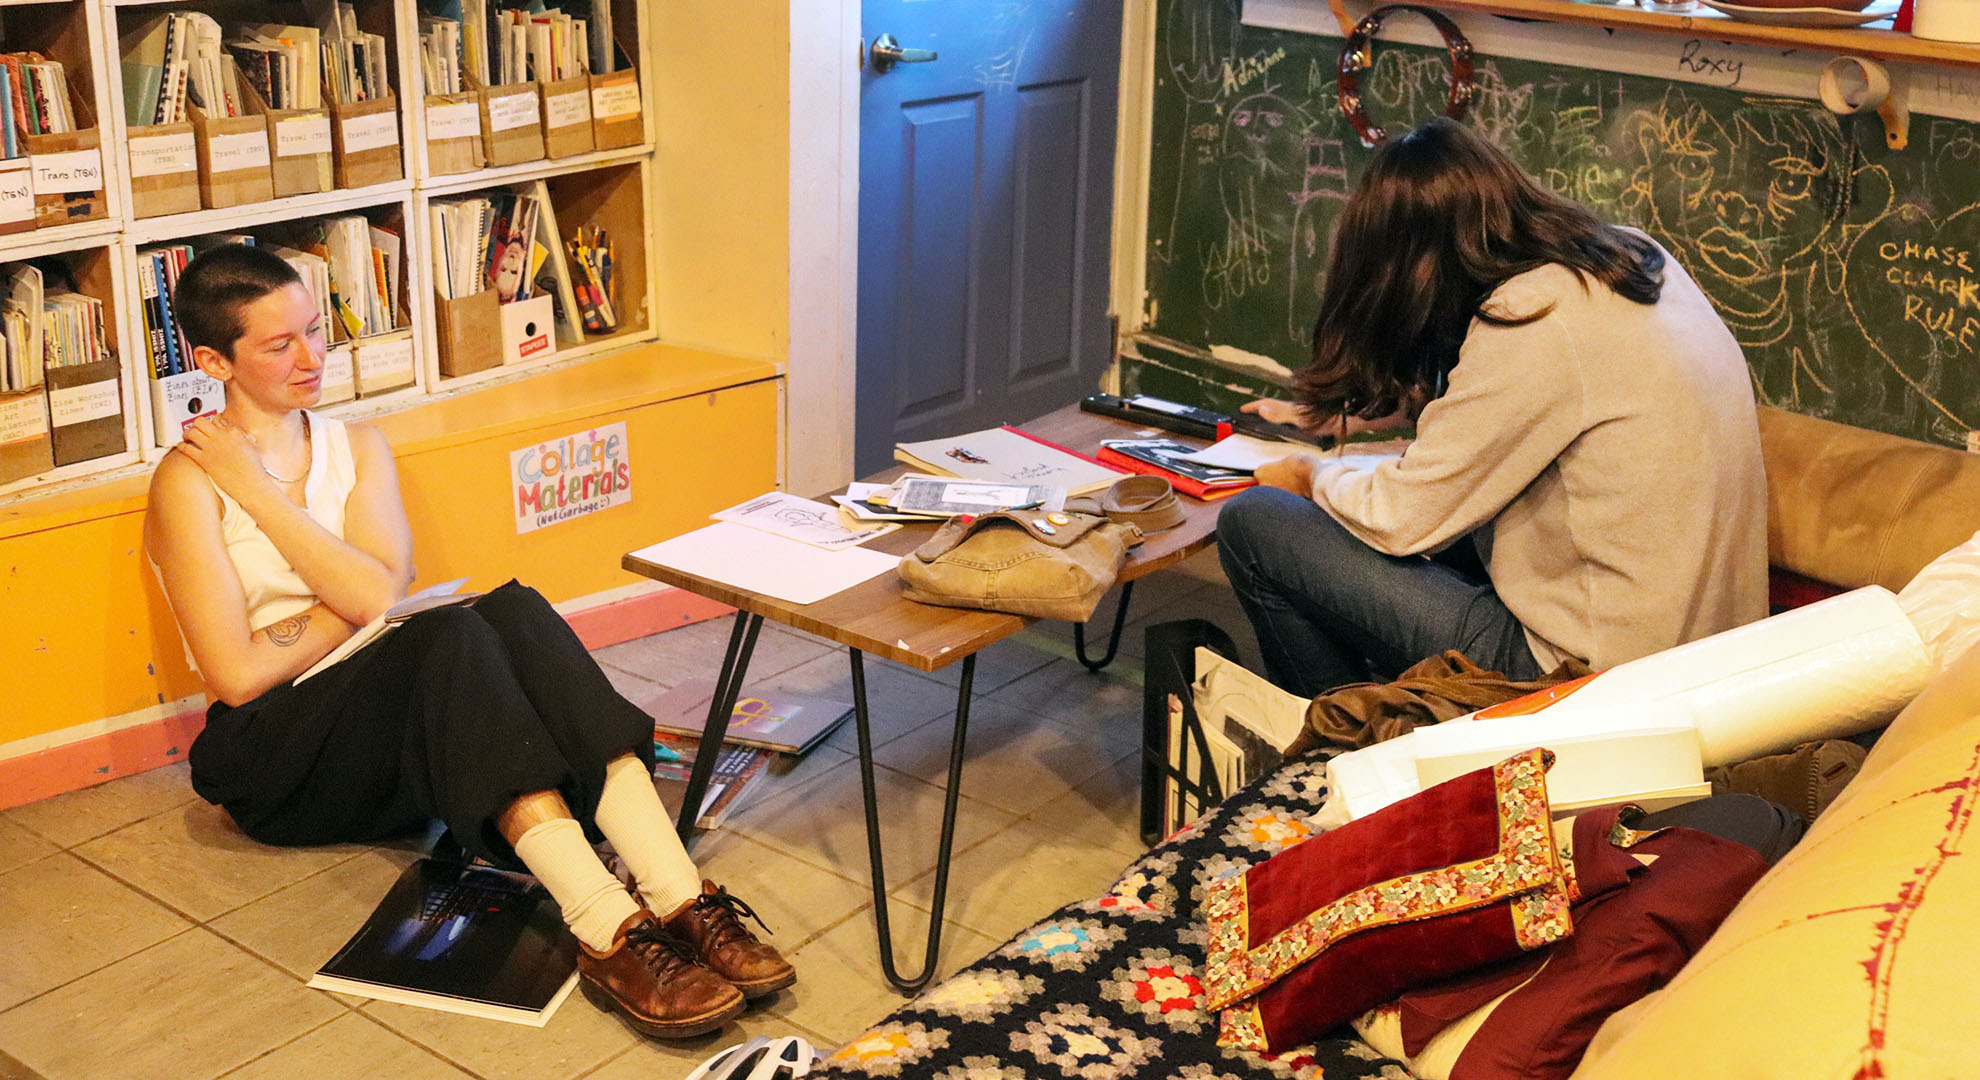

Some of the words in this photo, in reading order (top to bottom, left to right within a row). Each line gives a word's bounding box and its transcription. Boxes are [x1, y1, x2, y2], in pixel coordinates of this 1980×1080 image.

[1678, 39, 1743, 88] Roxy
[214, 149, 241, 159] Travel
[38, 168, 70, 181] Trans
[1879, 240, 1975, 274] CHASE
[1886, 266, 1980, 313] CLARK
[519, 434, 620, 484] Collage
[519, 458, 630, 517] Materials
[559, 501, 599, 520] Garbage
